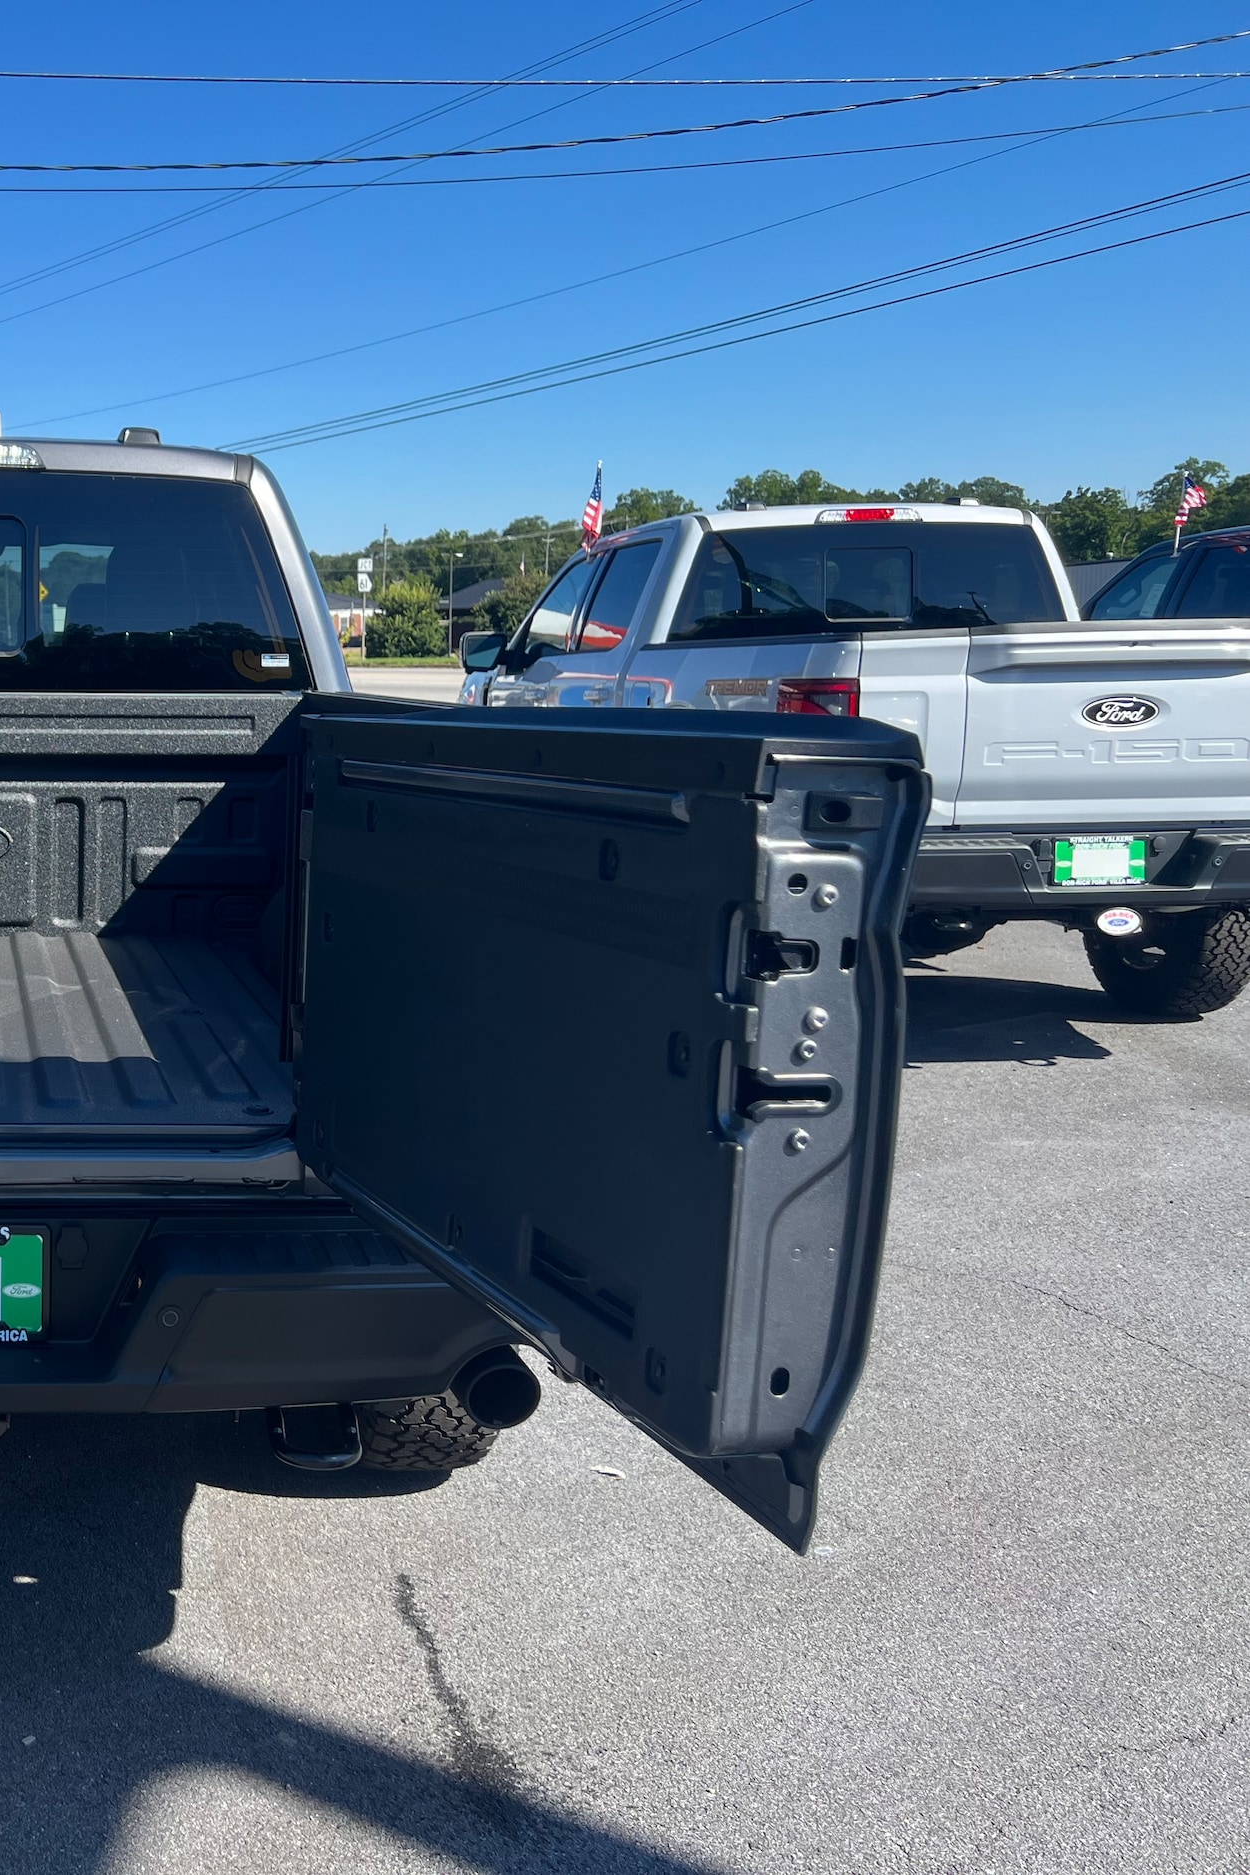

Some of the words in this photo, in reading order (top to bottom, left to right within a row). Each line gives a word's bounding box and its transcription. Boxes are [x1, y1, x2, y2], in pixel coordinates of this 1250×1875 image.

[359, 560, 372, 569] JCT
[359, 578, 368, 590] 61
[705, 680, 768, 696] TREMOR
[1095, 700, 1147, 722] Ford
[983, 738, 1250, 766] F-150
[9, 1285, 34, 1296] Ford
